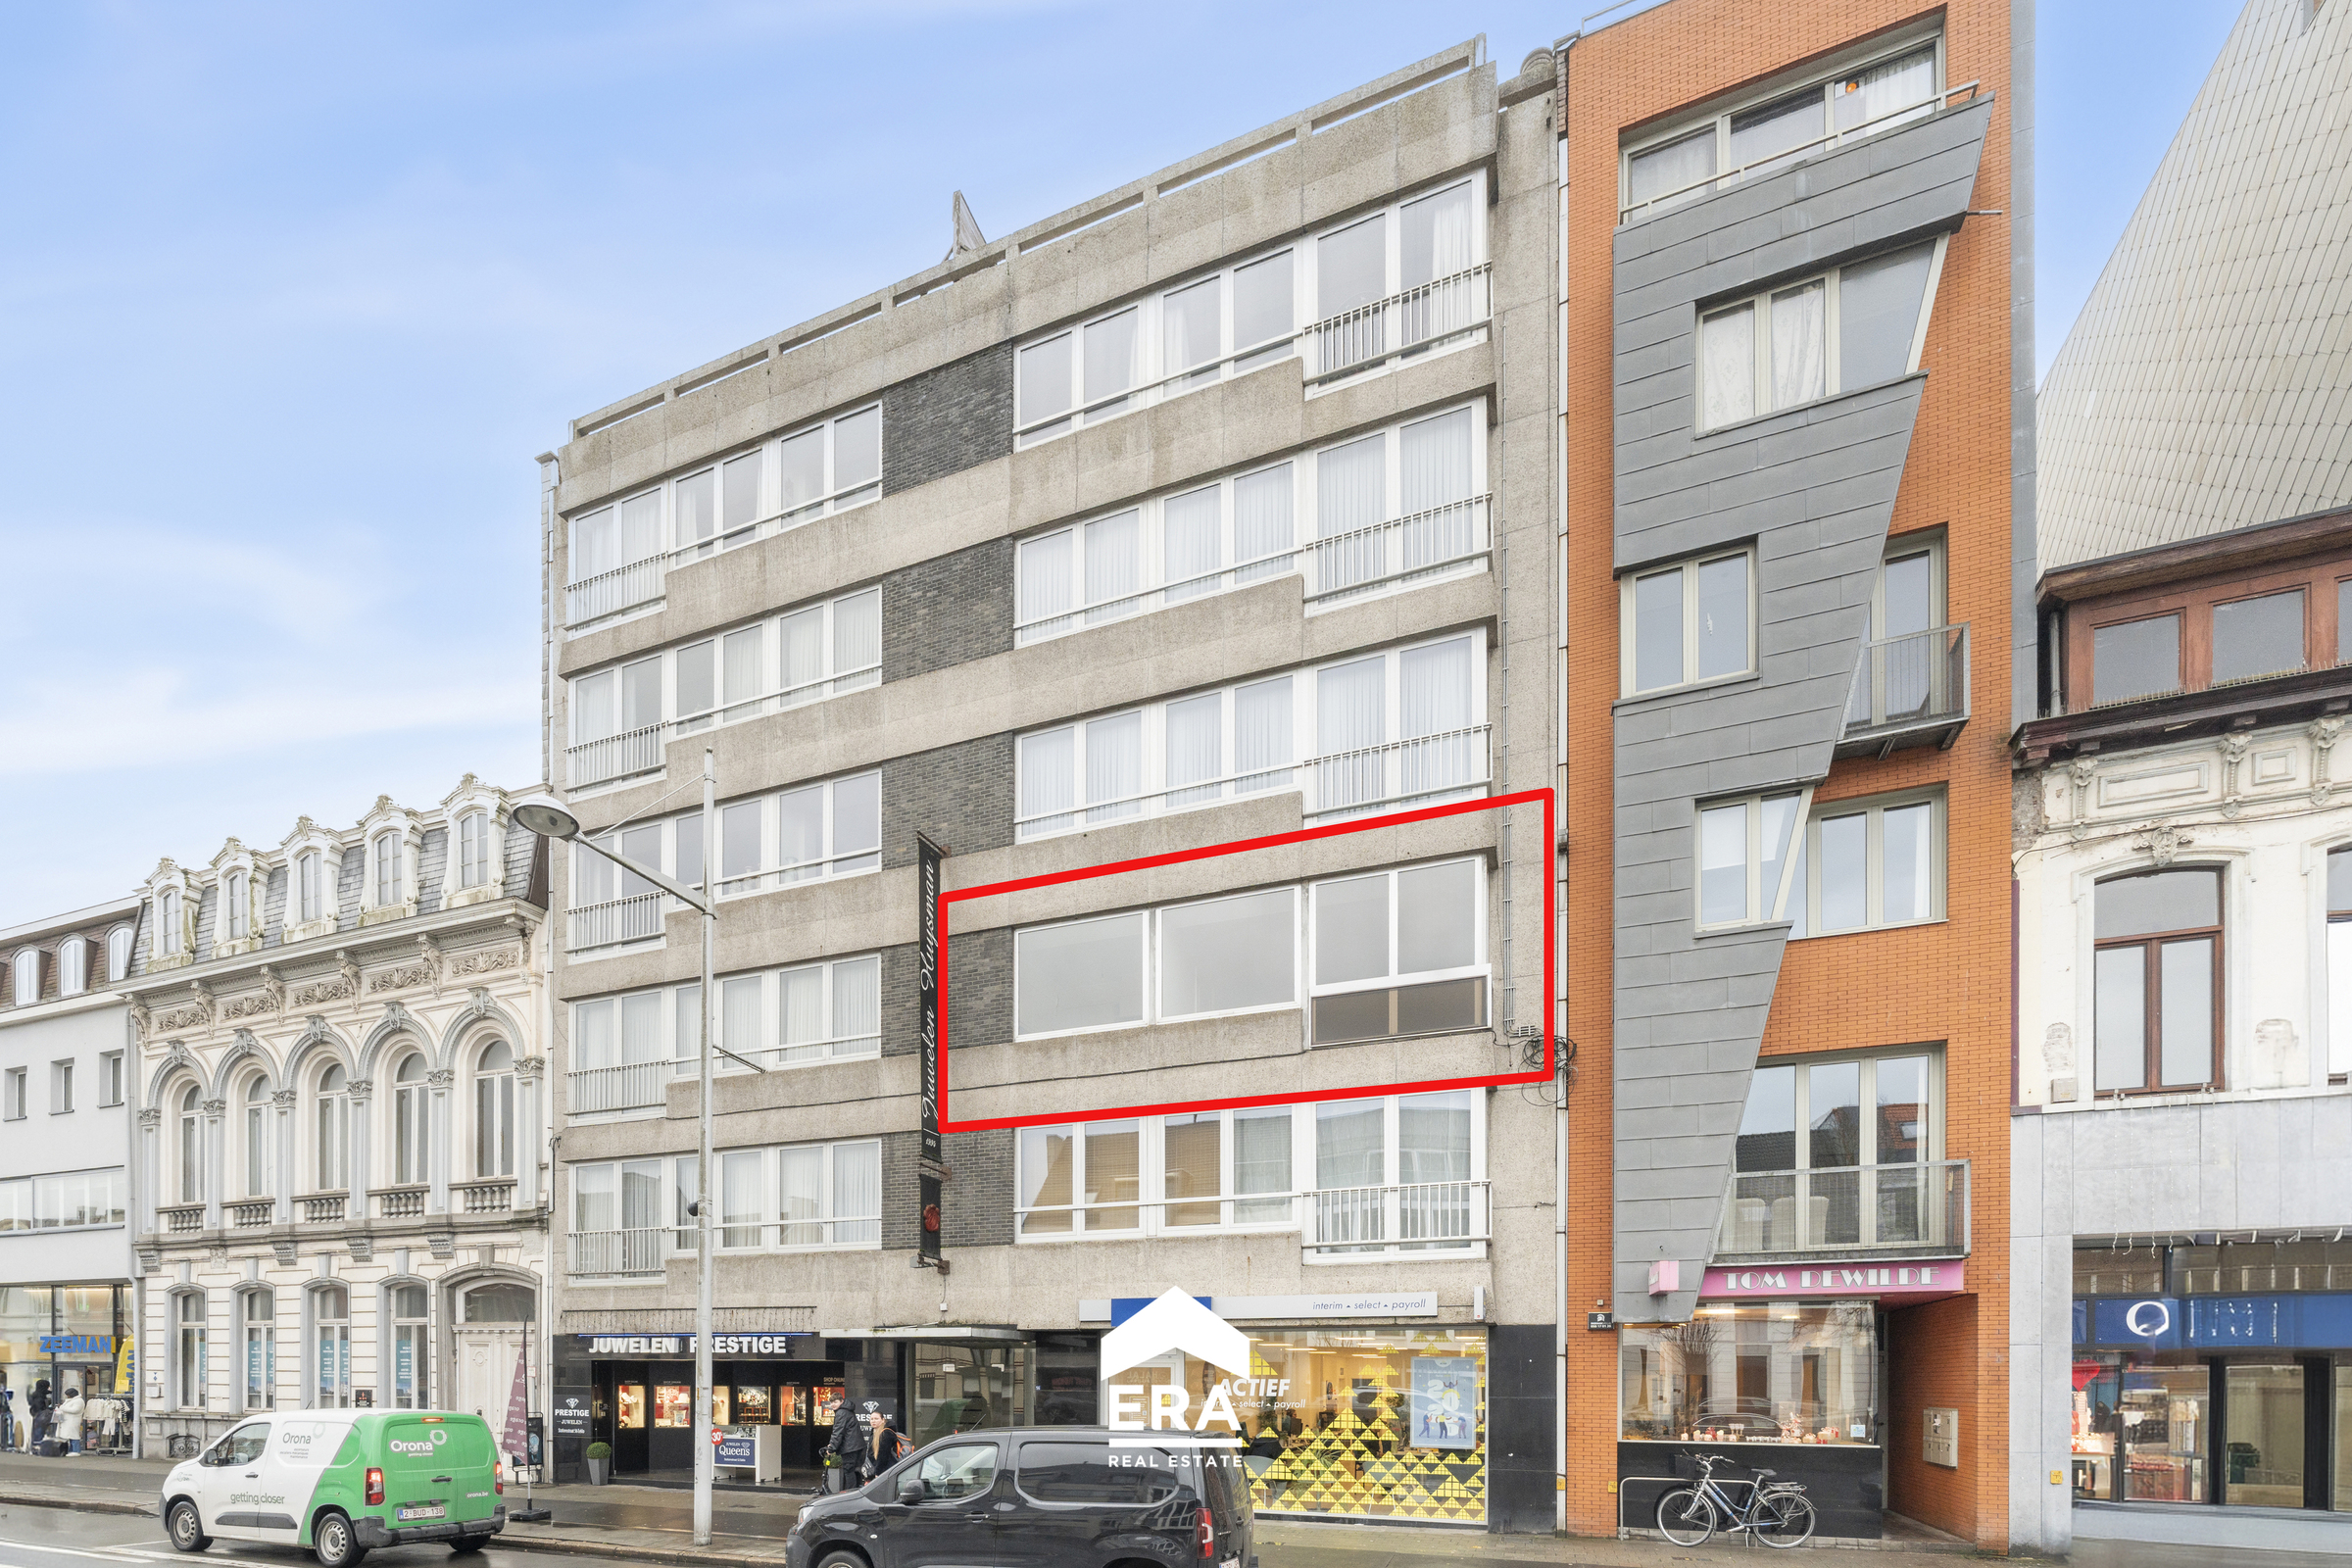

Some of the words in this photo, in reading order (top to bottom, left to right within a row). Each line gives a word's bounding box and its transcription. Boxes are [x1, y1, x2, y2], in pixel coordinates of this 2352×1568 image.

[1723, 1272, 1788, 1290] TOM
[1800, 1267, 1941, 1289] DEWILDE
[1354, 1299, 1381, 1309] select
[1392, 1298, 1426, 1310] payroll
[40, 1336, 111, 1353] ZEEMAN
[589, 1337, 679, 1353] JUWELEN
[690, 1337, 787, 1353] PESTIGE
[1221, 1379, 1291, 1396] ACTIEF
[1239, 1398, 1264, 1408] select
[1274, 1399, 1306, 1410] payroll
[282, 1432, 312, 1445] Orona
[390, 1440, 433, 1452] Orona
[230, 1491, 259, 1505] getting
[260, 1492, 285, 1504] closer
